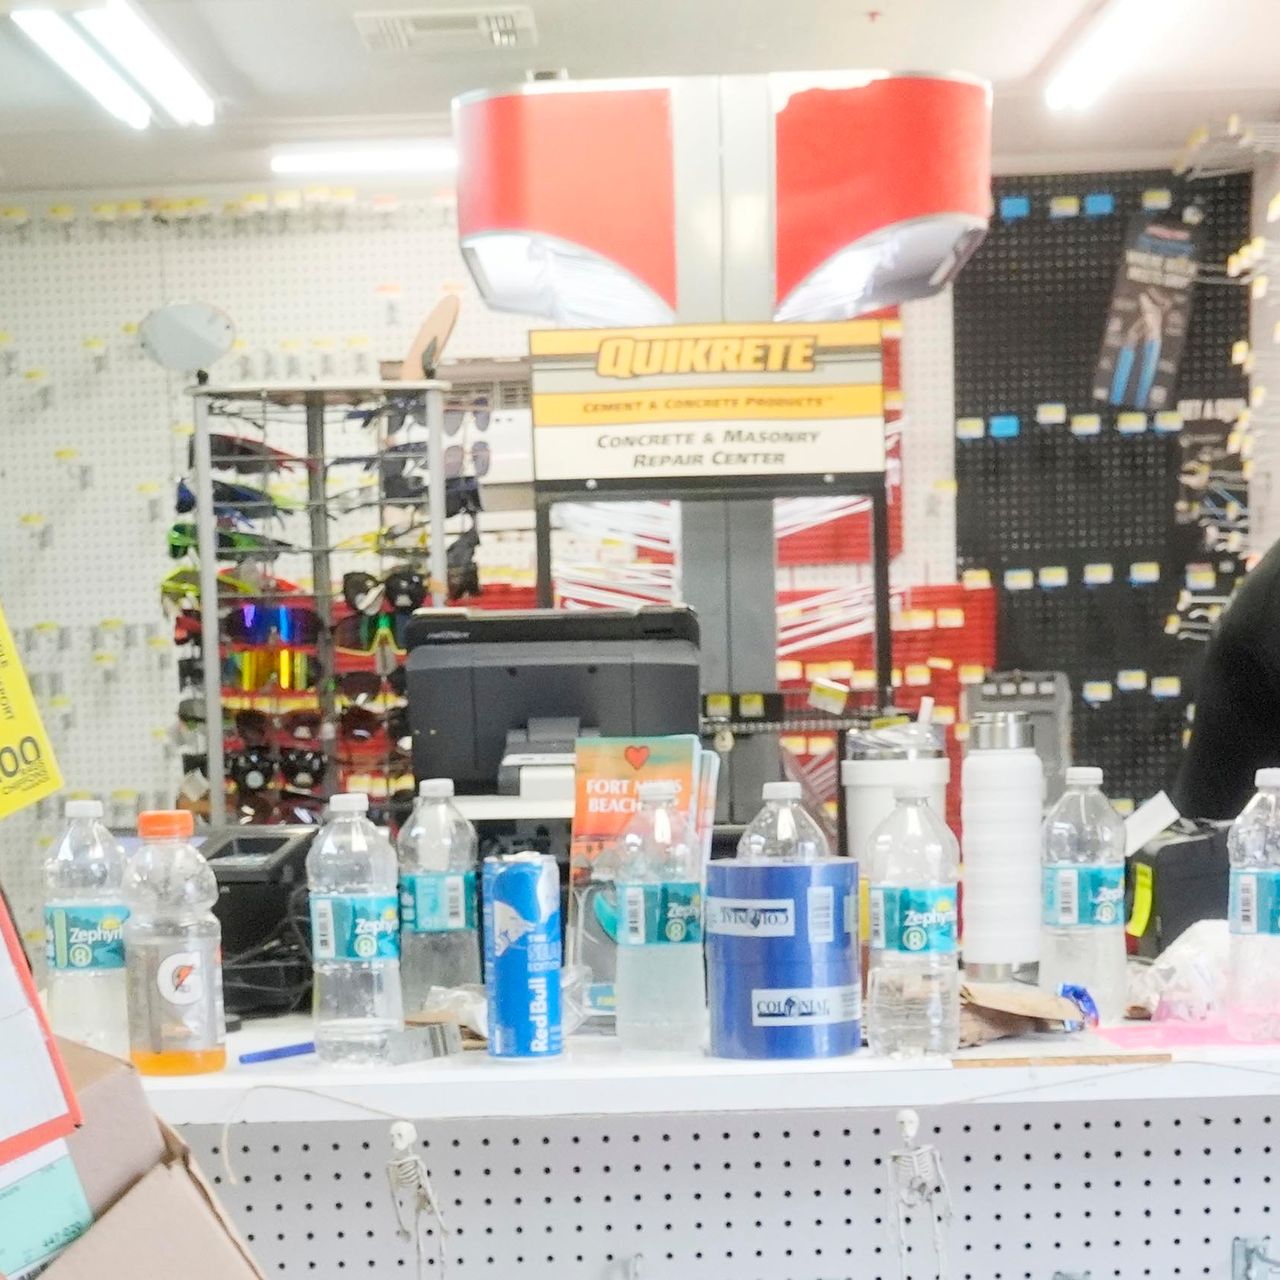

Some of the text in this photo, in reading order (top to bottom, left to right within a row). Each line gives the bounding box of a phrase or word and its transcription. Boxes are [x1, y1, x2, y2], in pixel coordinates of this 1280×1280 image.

[596, 336, 816, 378] QUIKRETE
[664, 398, 739, 410] CONCRETE
[597, 430, 821, 449] CONCRETE & MASONRY
[633, 450, 786, 468] REPAIR CENTER
[585, 779, 631, 794] FORT
[587, 796, 642, 812] BEACH
[527, 977, 548, 1013] Bull
[528, 1013, 549, 1053] Red
